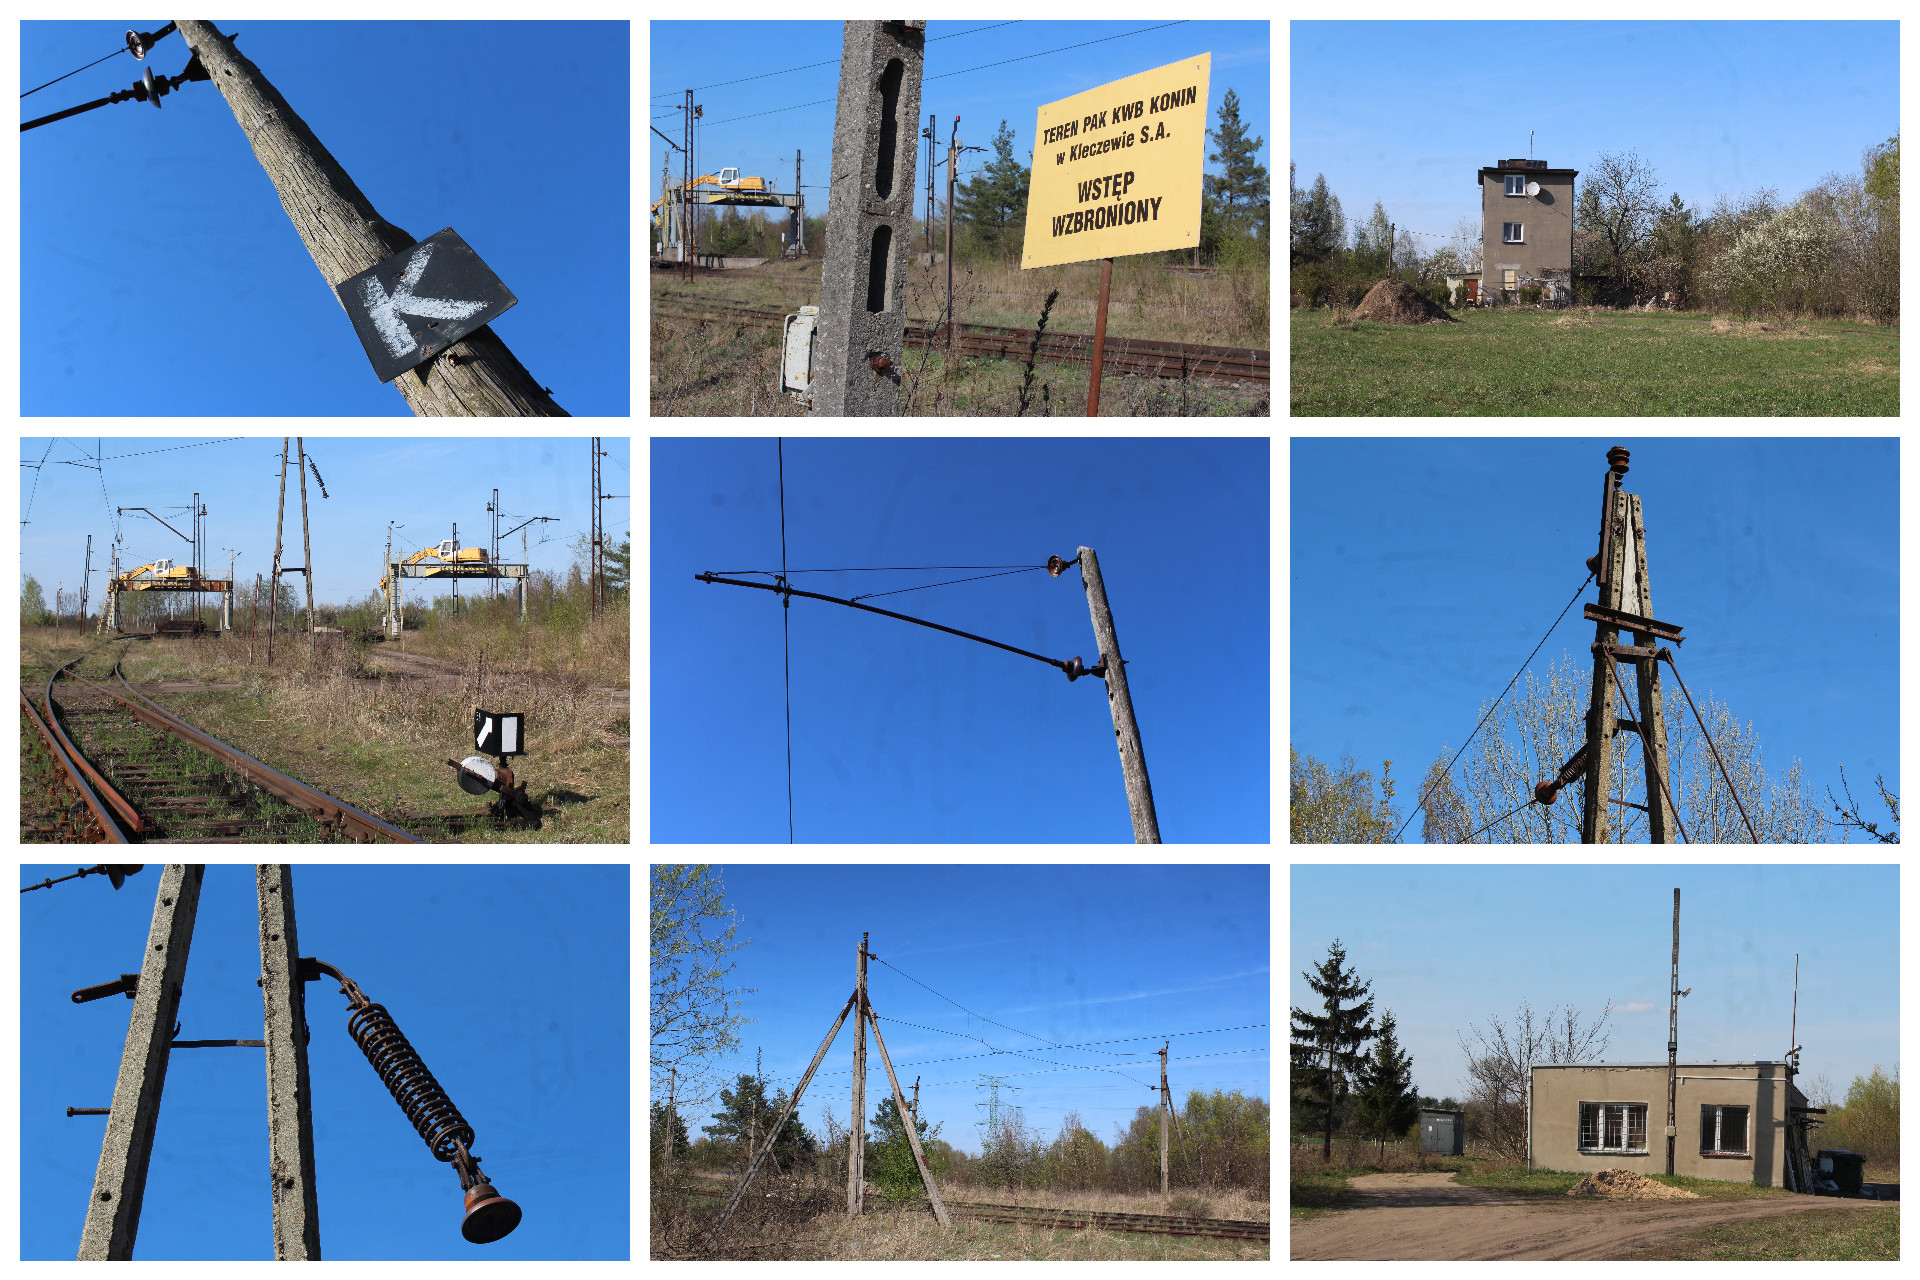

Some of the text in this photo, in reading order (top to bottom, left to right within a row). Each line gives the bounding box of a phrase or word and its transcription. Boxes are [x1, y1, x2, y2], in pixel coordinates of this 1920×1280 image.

[1043, 85, 1197, 146] TEREN PAK KWB KONIN
[1056, 121, 1171, 166] w Kleczewie S.A.
[1078, 170, 1135, 204] WSTĘP
[1052, 196, 1163, 238] WZBRONIONY
[358, 242, 491, 359] K
